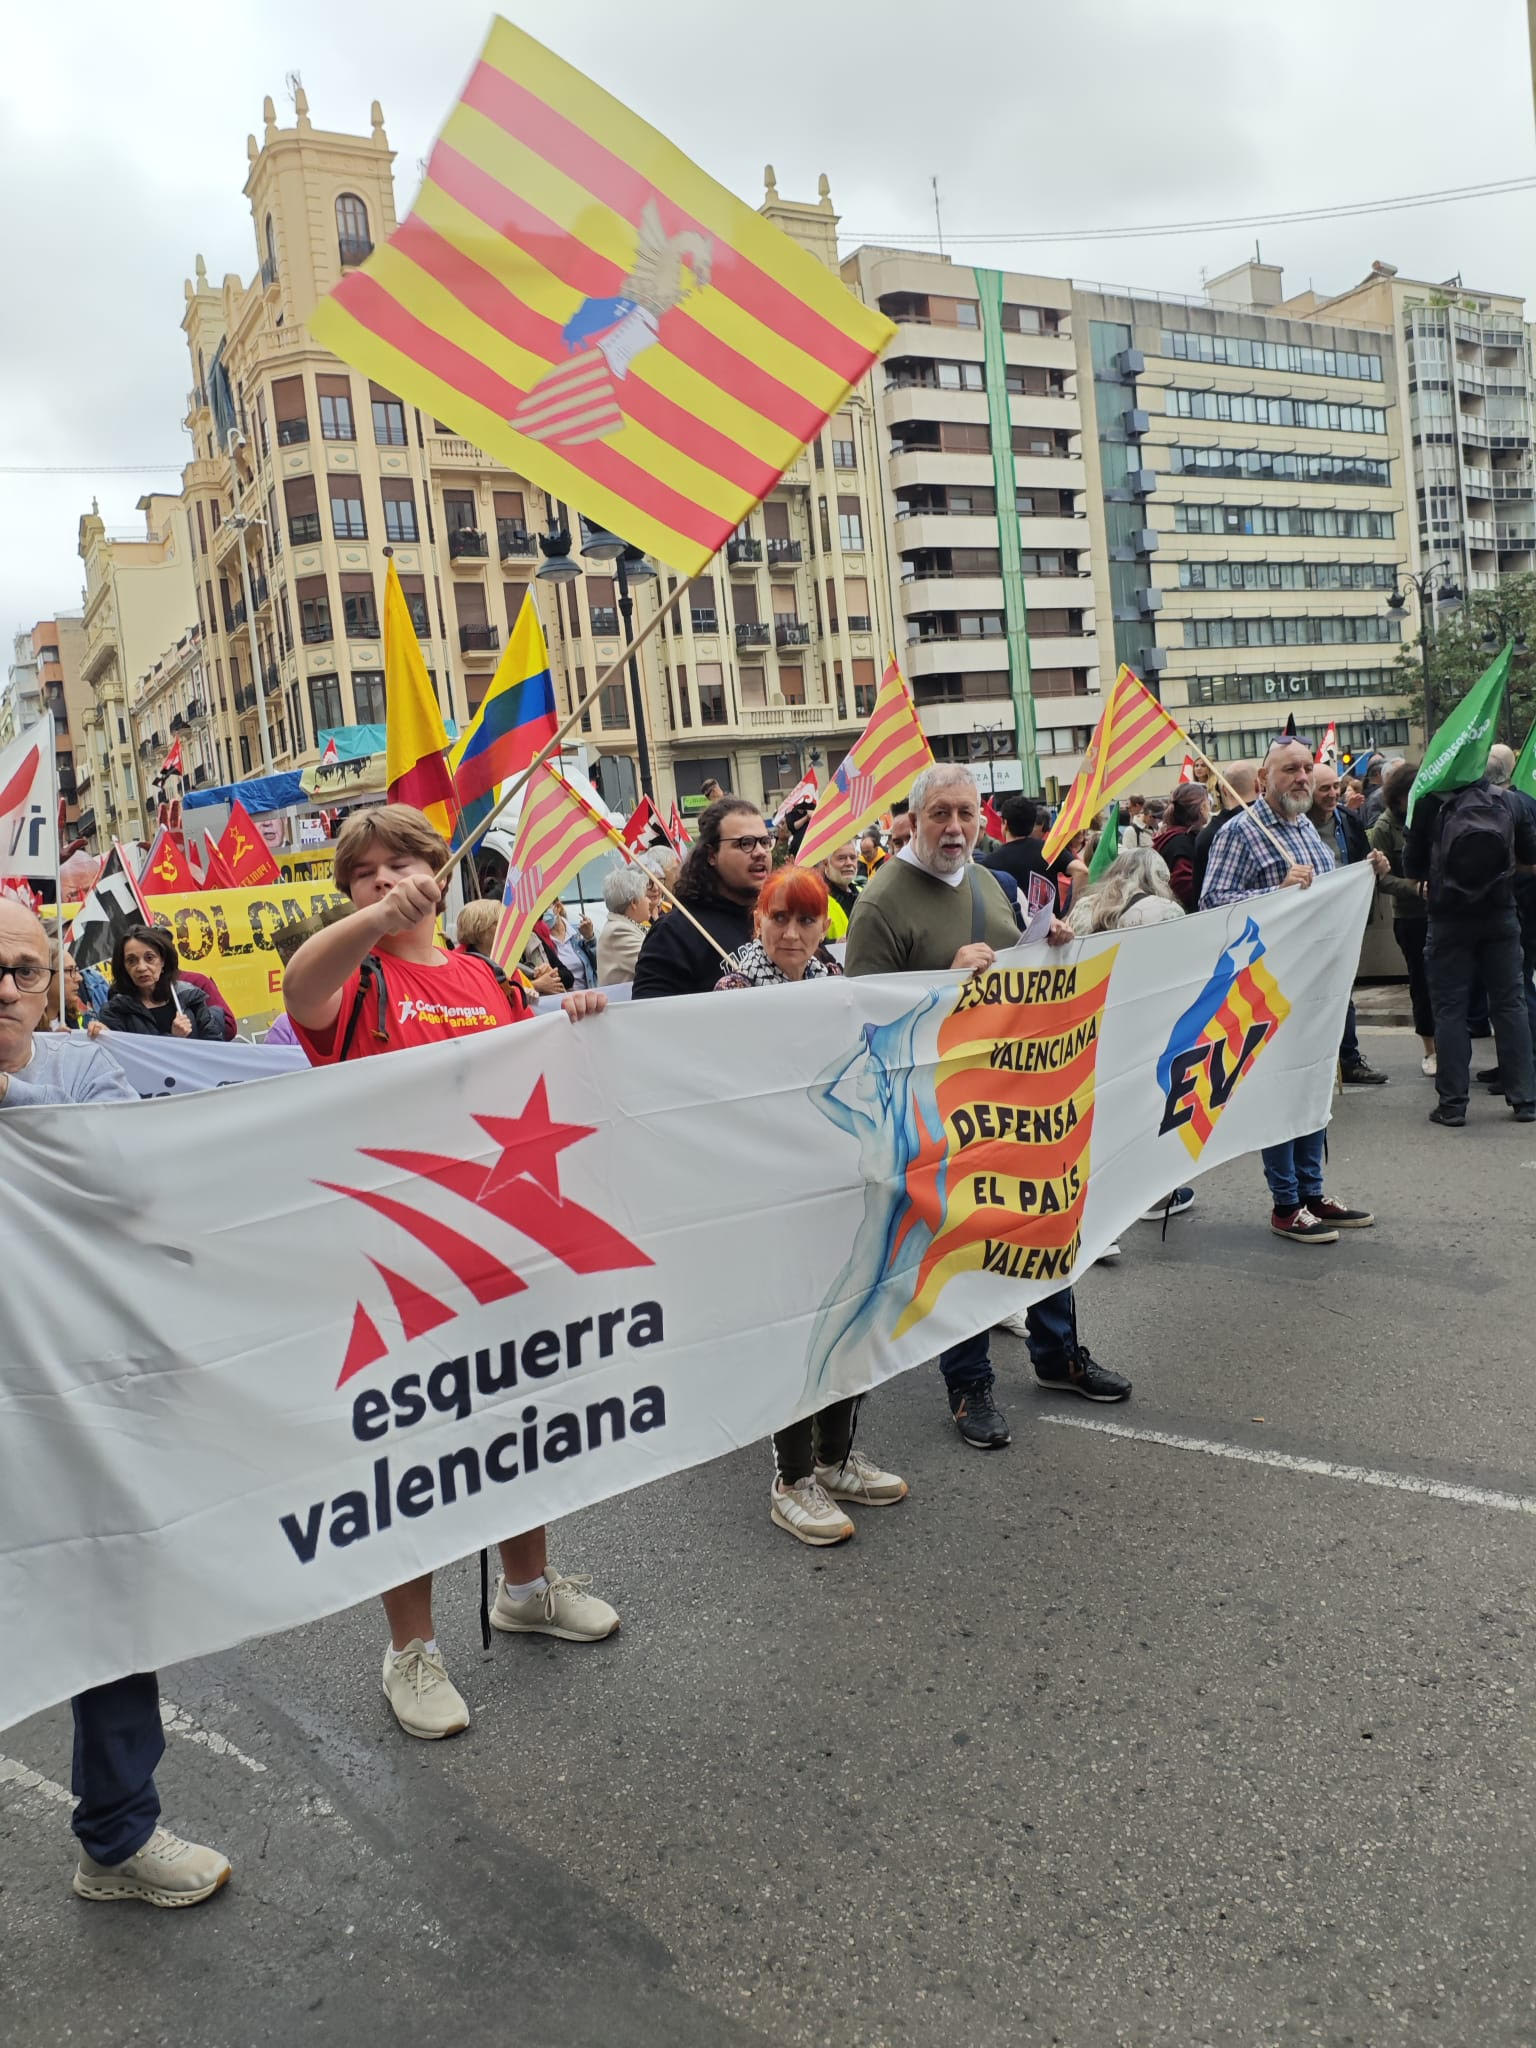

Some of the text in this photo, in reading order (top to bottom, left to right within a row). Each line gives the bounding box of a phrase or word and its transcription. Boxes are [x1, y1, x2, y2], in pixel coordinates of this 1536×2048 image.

[1265, 677, 1309, 693] DIGI
[952, 966, 1078, 1013] ESQUERRA
[990, 1016, 1097, 1072] VALENCIANA
[1158, 1021, 1271, 1137] EV
[950, 1099, 1078, 1149] DEFENSA
[973, 1162, 1080, 1214] EL PAÍS
[353, 1300, 665, 1442] esquerra
[279, 1385, 667, 1564] valenciana
